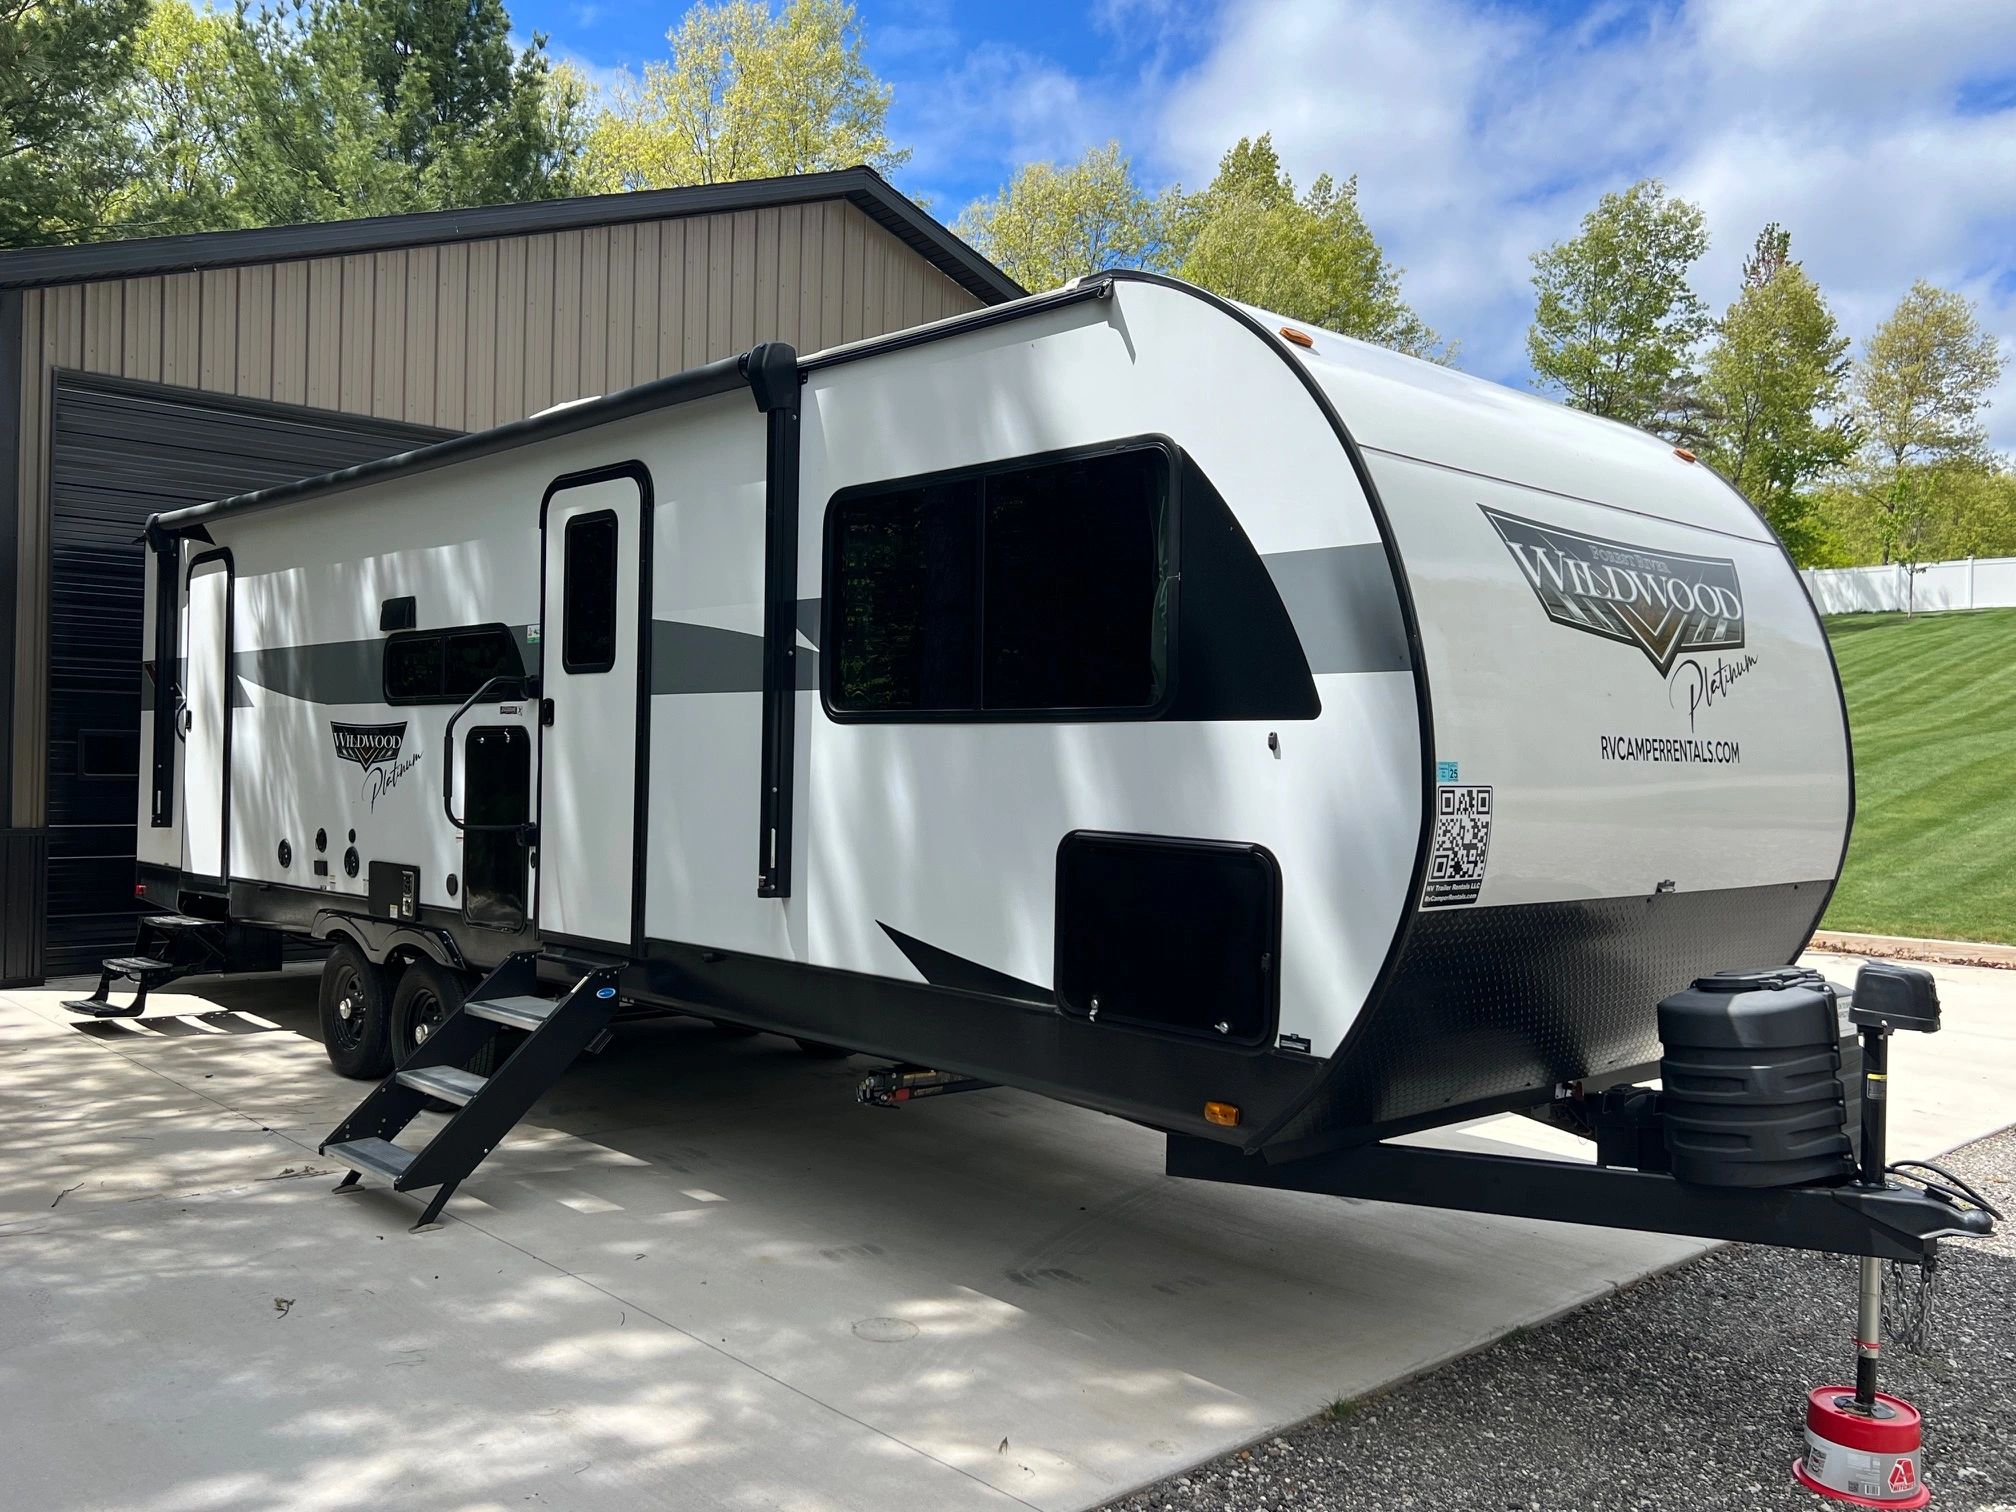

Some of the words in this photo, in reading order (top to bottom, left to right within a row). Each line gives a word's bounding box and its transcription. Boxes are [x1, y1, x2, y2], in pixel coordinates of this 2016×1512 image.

[1505, 541, 1743, 620] WILDWOOD
[1669, 653, 1759, 734] Platinum
[334, 732, 402, 749] WILDWOOD
[1600, 736, 1741, 764] RVCAMPERRENTALS.COM
[361, 752, 424, 814] Platinum
[1449, 768, 1458, 779] 25
[1470, 882, 1481, 890] LLC
